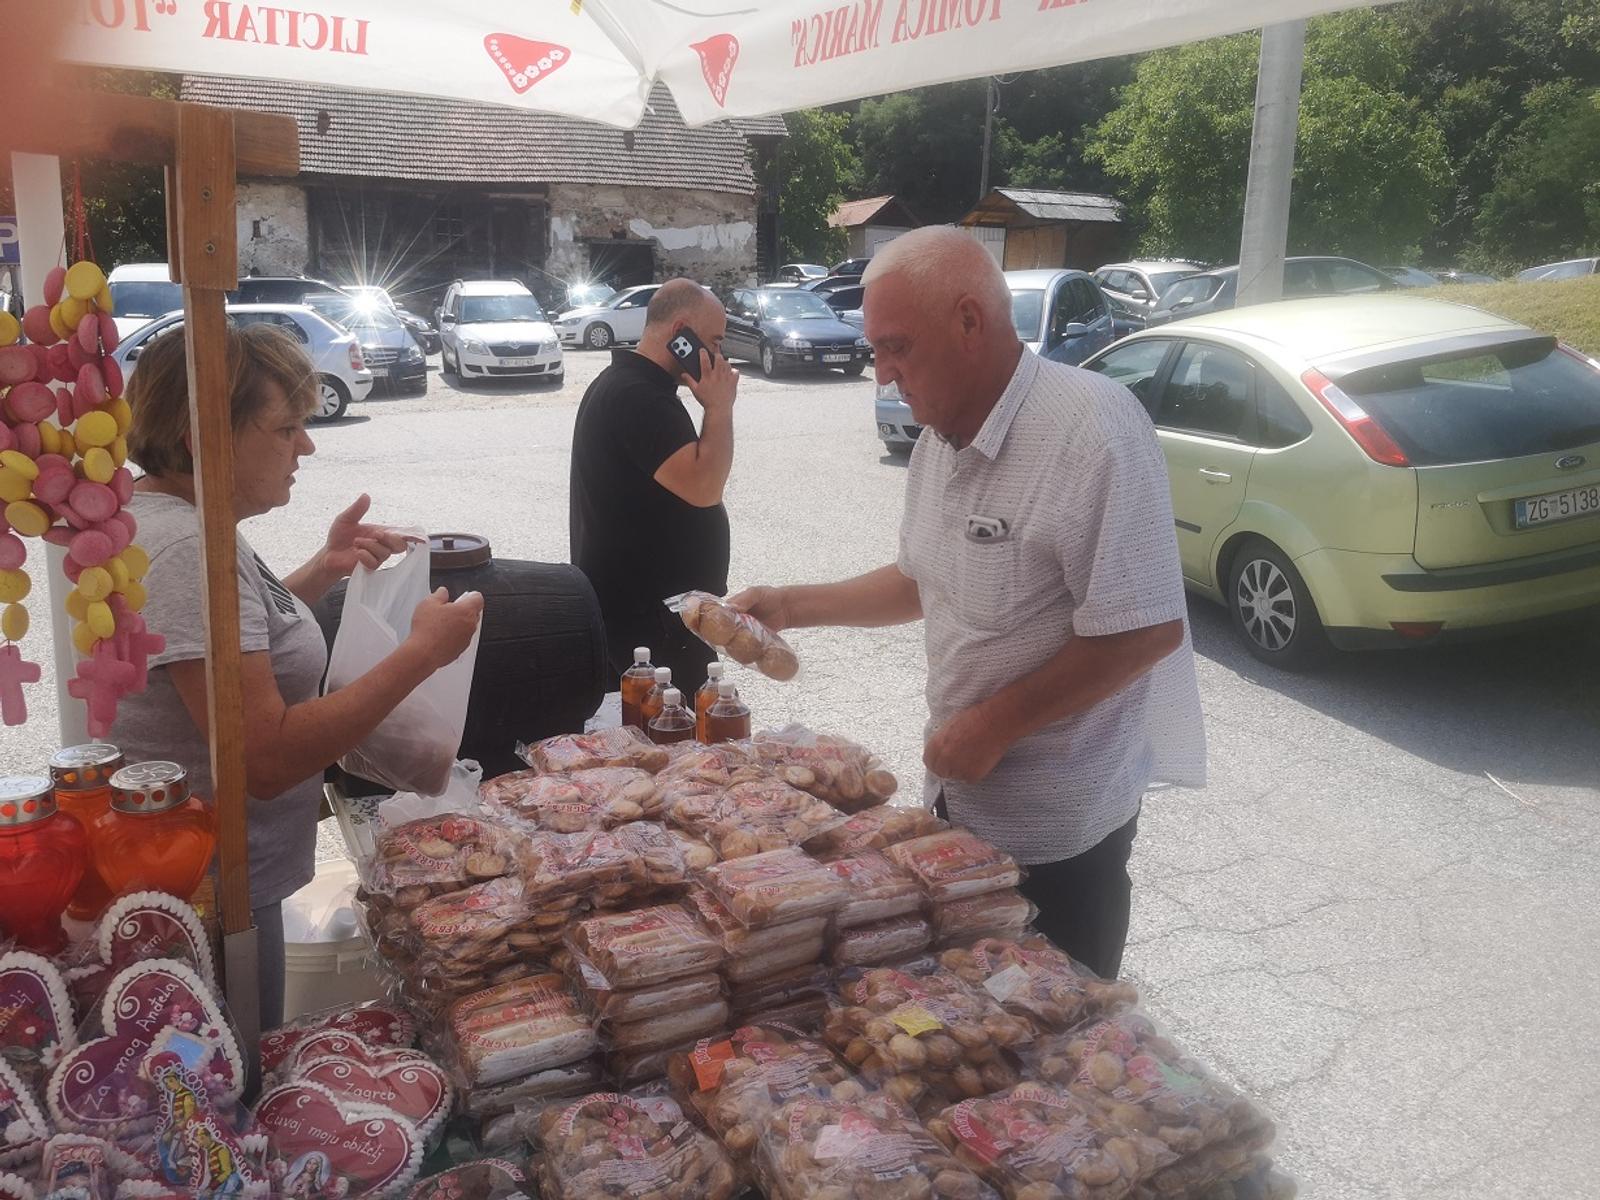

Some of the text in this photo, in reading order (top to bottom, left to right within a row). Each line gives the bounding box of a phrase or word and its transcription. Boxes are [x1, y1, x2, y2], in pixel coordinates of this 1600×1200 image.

[1528, 499, 1549, 522] ZG
[84, 1085, 113, 1112] Za
[341, 1082, 397, 1102] Zagreb
[264, 1106, 386, 1165] Čuvaj moju obitelj
